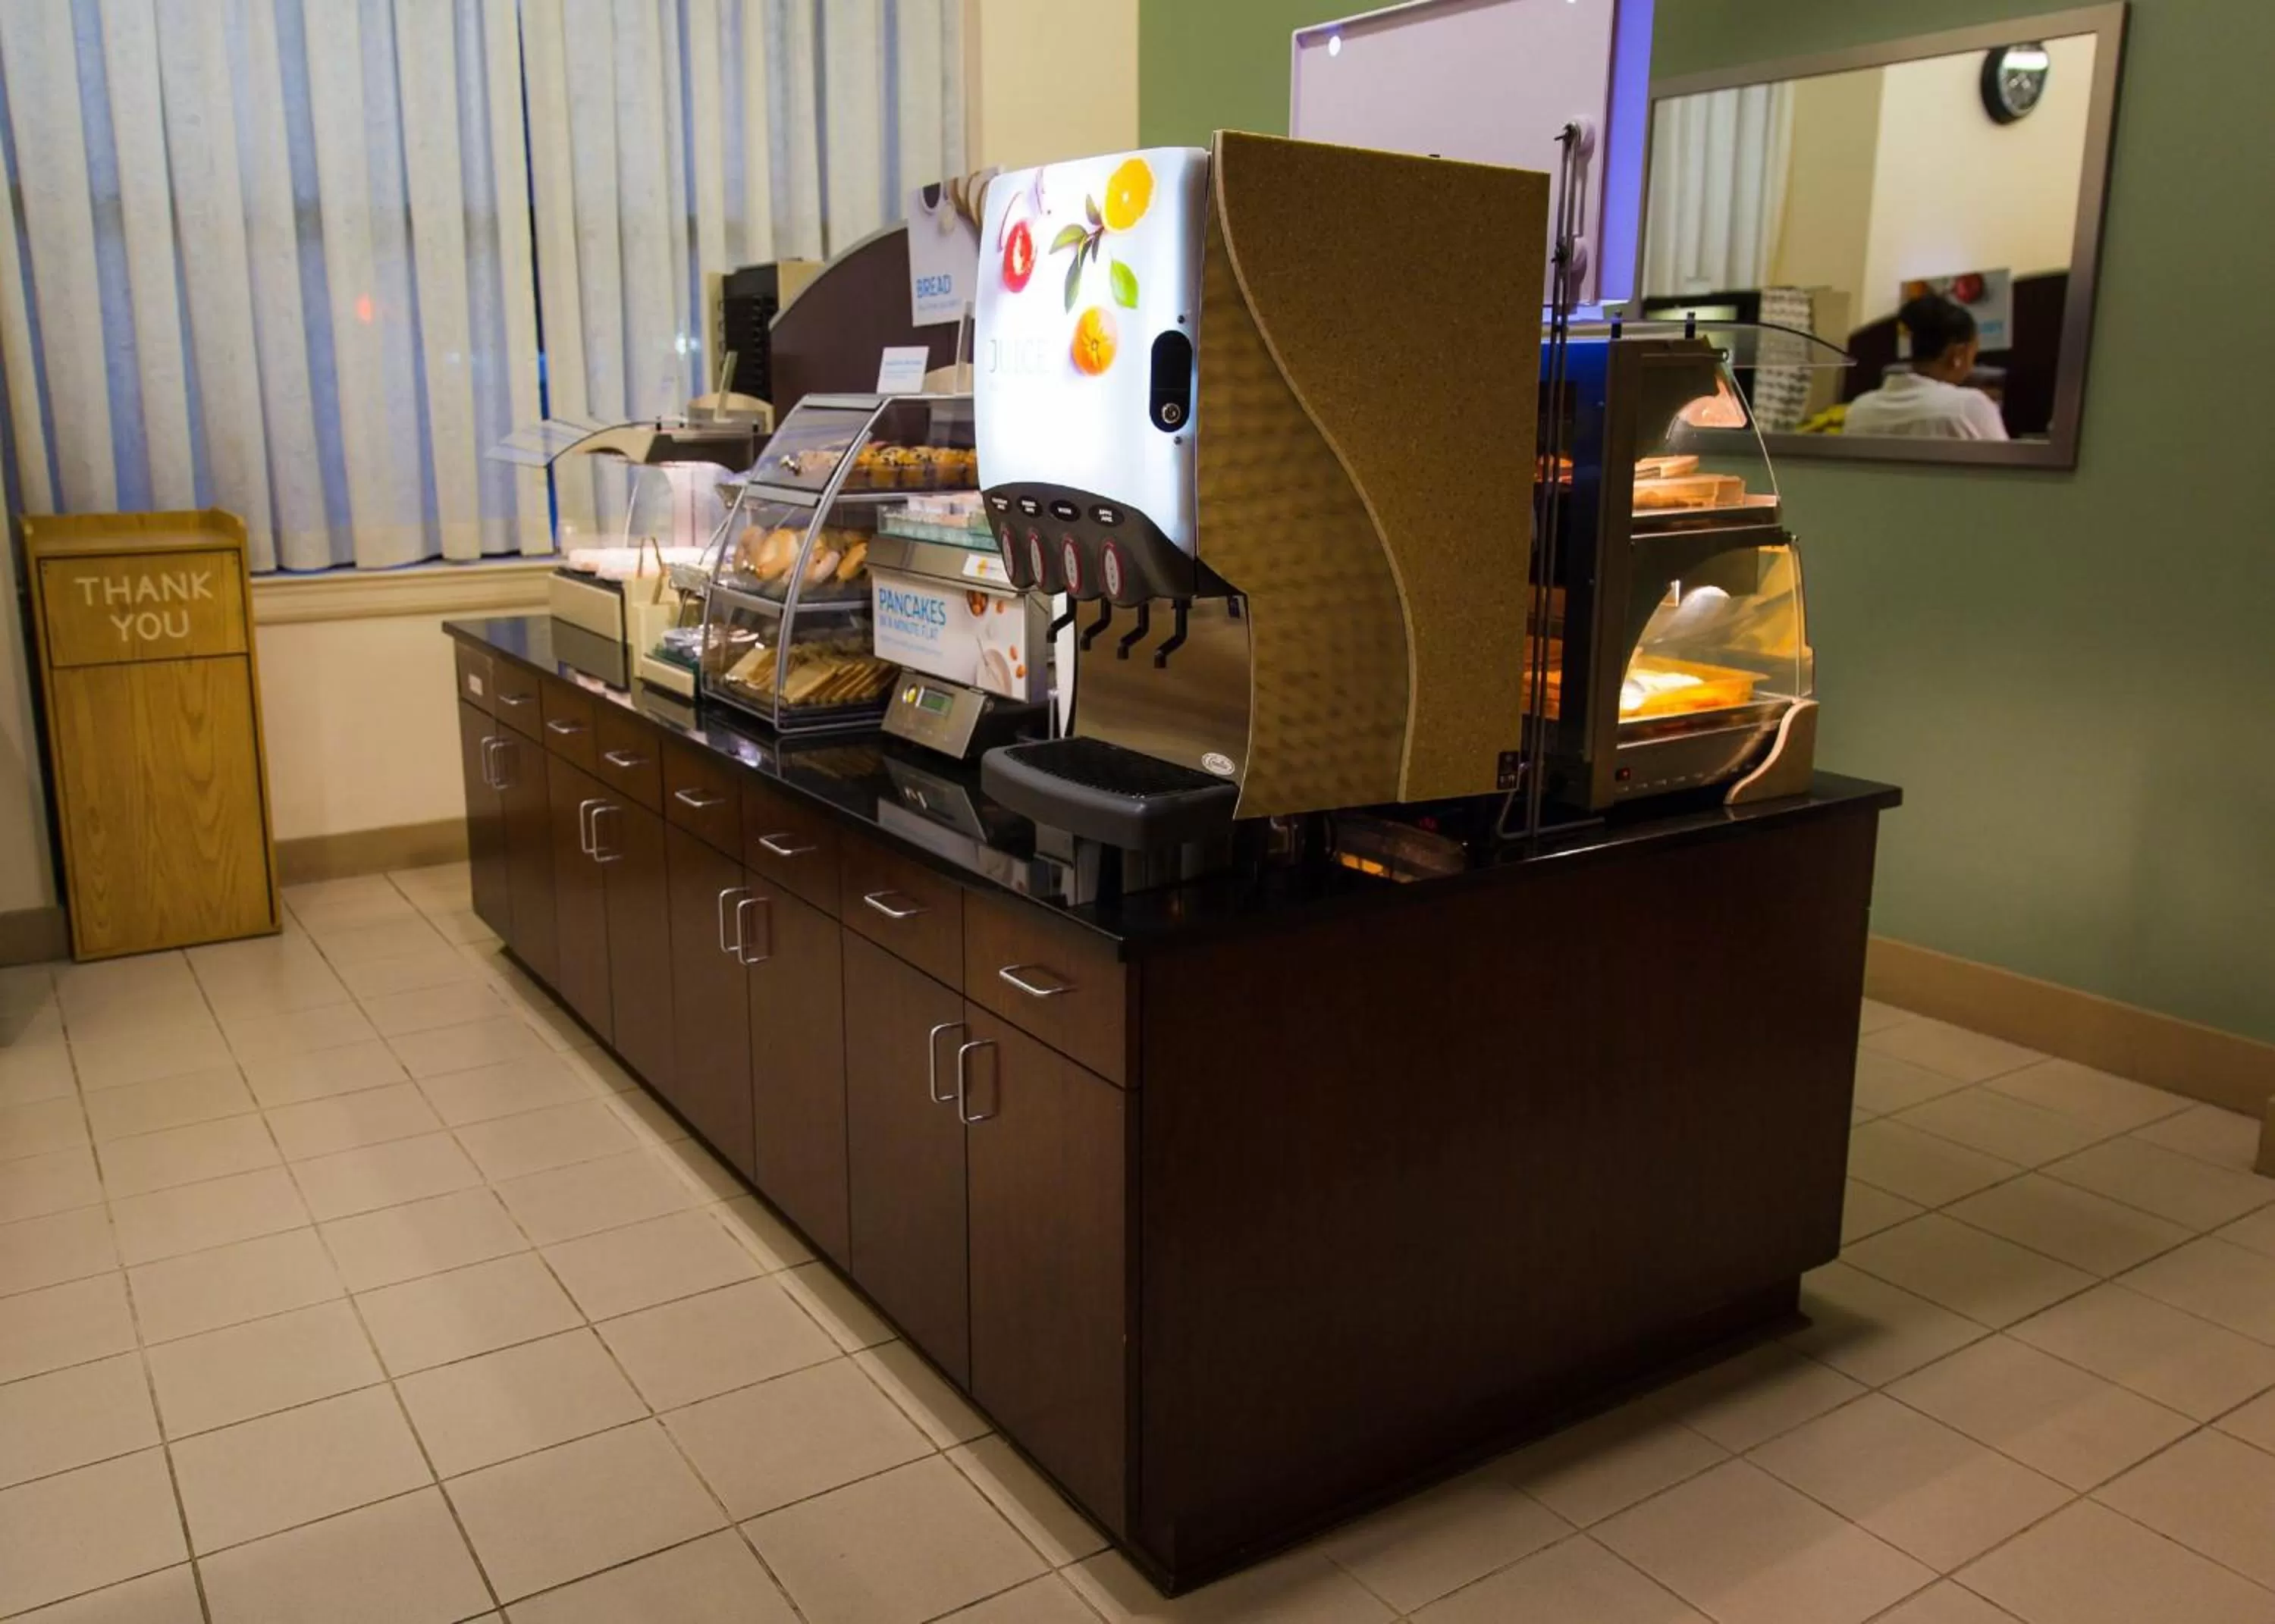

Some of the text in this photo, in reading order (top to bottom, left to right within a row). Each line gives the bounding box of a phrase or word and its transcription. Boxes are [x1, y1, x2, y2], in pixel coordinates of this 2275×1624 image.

[916, 274, 952, 298] BREAD
[74, 571, 213, 606] THANK
[878, 588, 946, 625] PANCAKES
[110, 609, 190, 642] YOU
